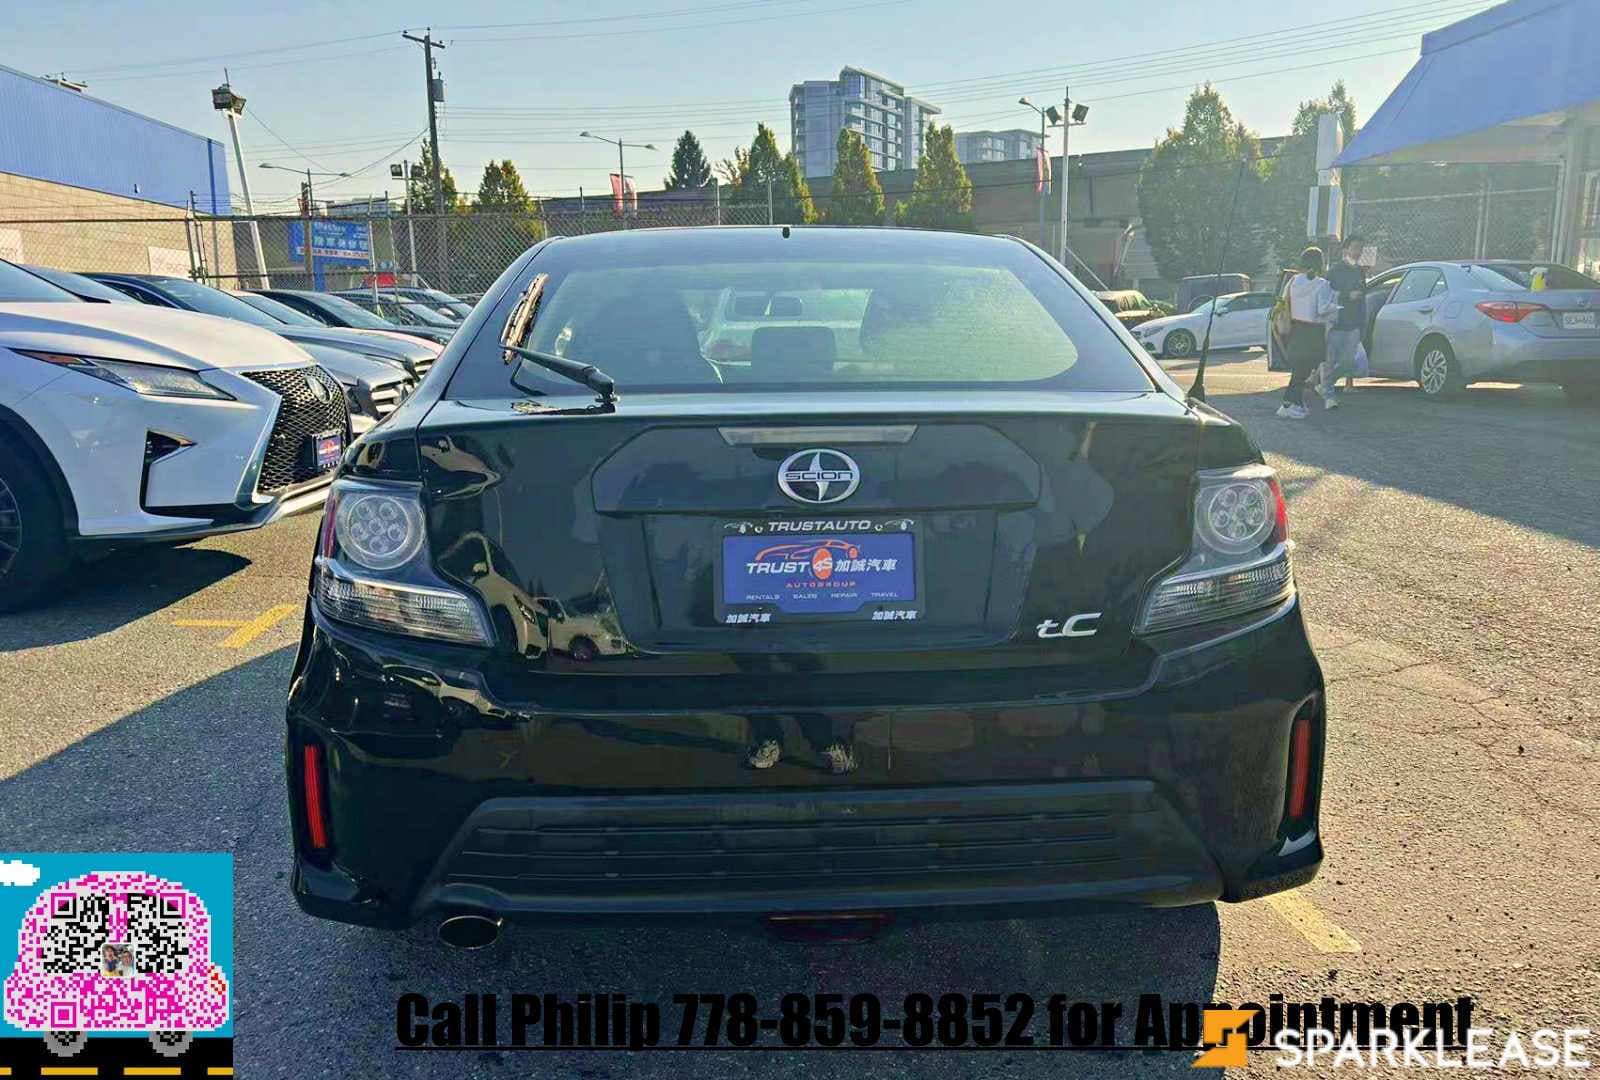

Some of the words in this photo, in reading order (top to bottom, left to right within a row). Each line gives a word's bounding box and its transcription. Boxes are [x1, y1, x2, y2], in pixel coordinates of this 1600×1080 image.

[785, 471, 854, 481] SCION
[768, 520, 872, 532] TRUSTAUTO
[746, 561, 811, 574] TRUST
[1036, 612, 1102, 639] tC
